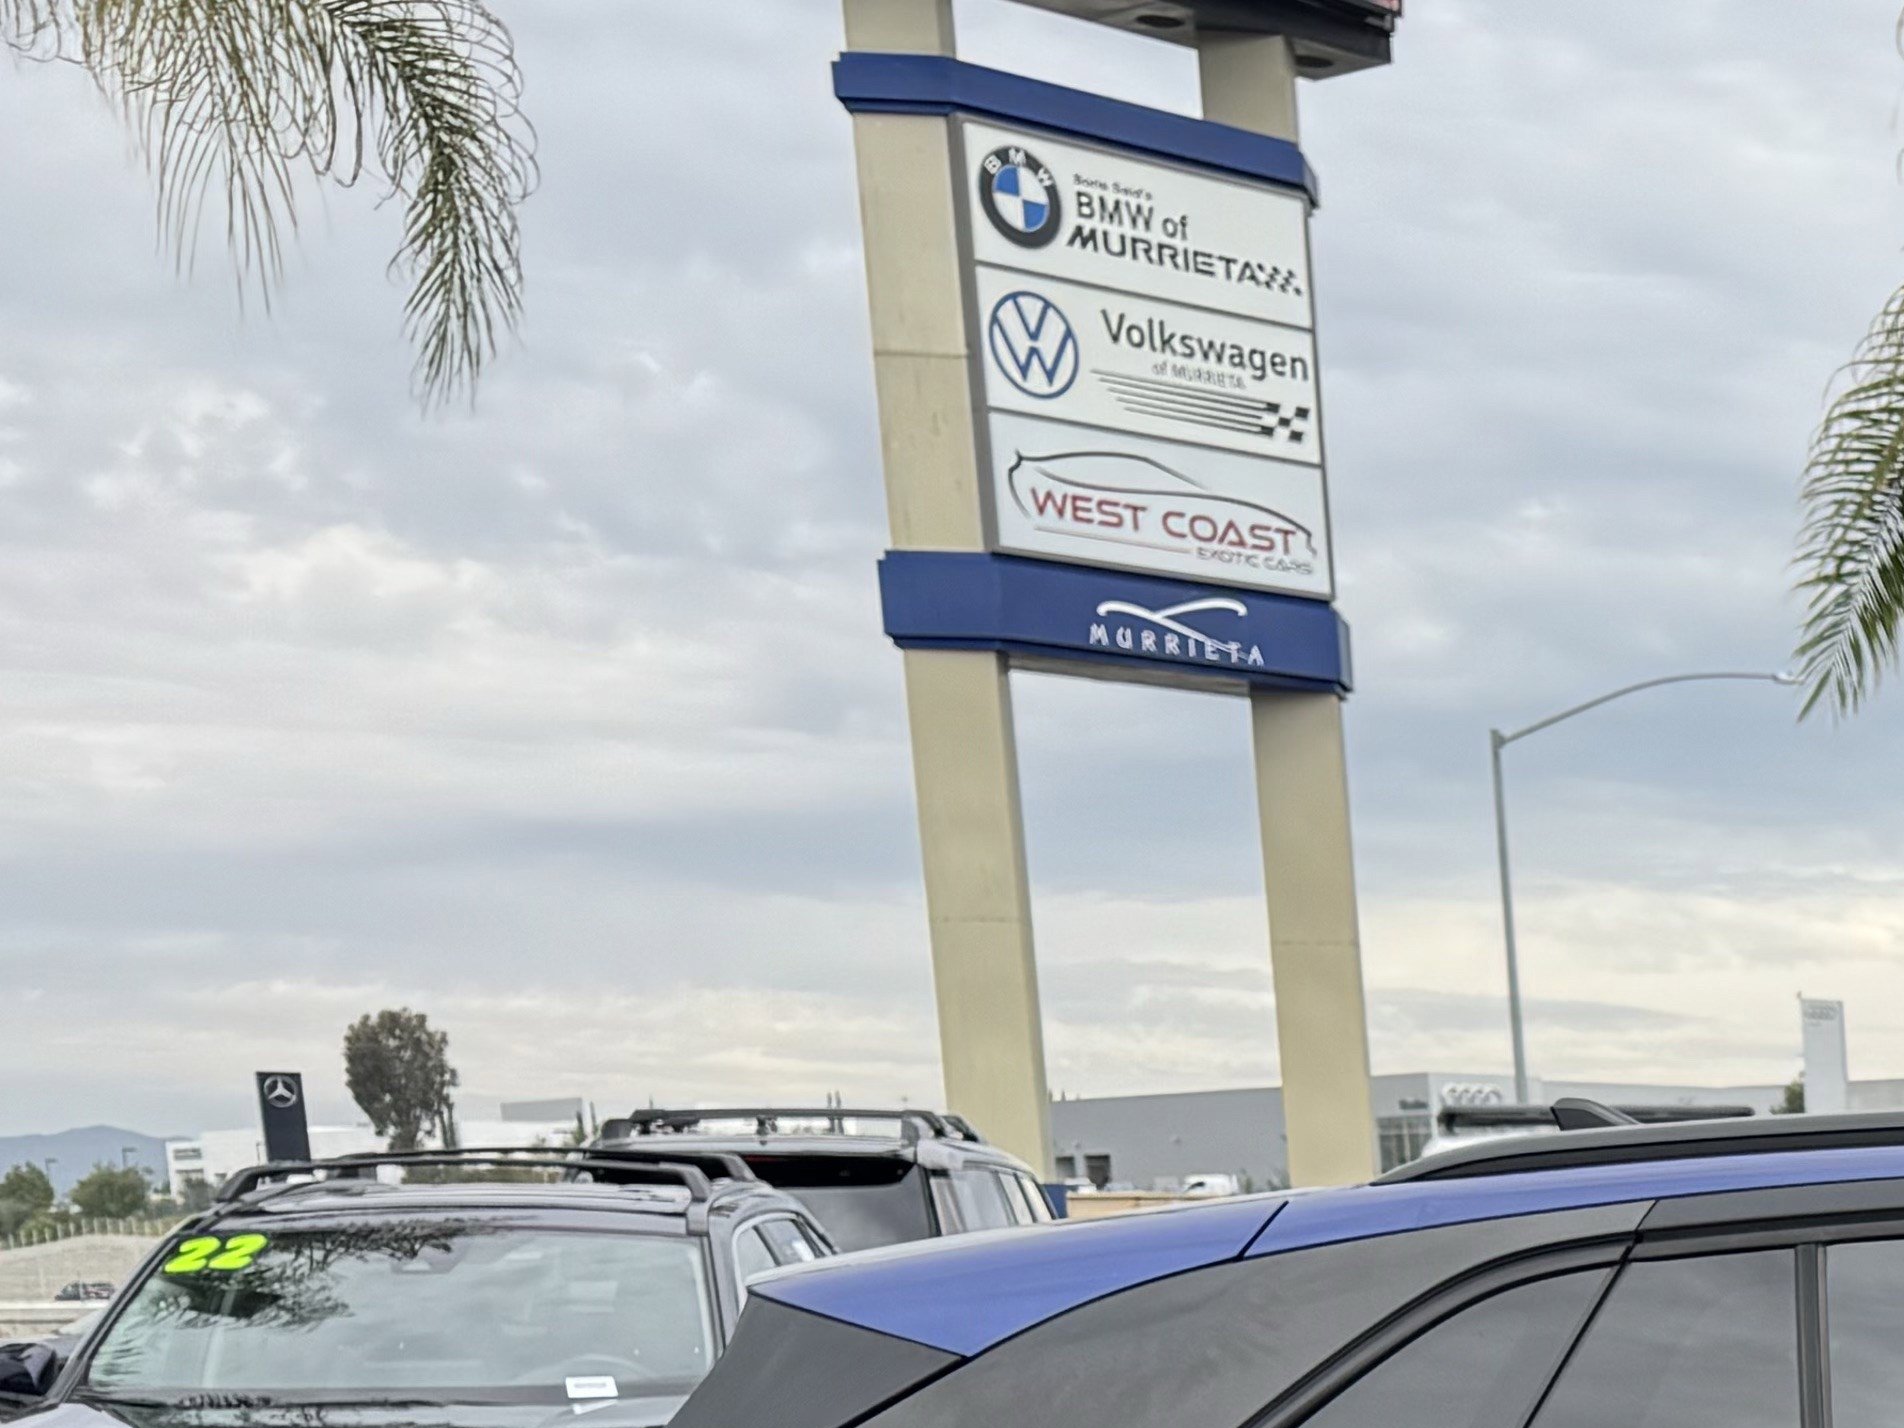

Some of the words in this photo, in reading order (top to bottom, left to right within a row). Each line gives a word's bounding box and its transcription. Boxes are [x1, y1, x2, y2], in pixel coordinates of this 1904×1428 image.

[1076, 191, 1153, 231] BMW
[1162, 215, 1190, 241] of
[1067, 225, 1258, 284] MURRIETA
[1101, 308, 1309, 382] Volkswagen
[1030, 486, 1148, 532] WEST
[1161, 510, 1298, 555] COAST
[1089, 622, 1266, 668] MURRIETA
[164, 1233, 268, 1272] 22
